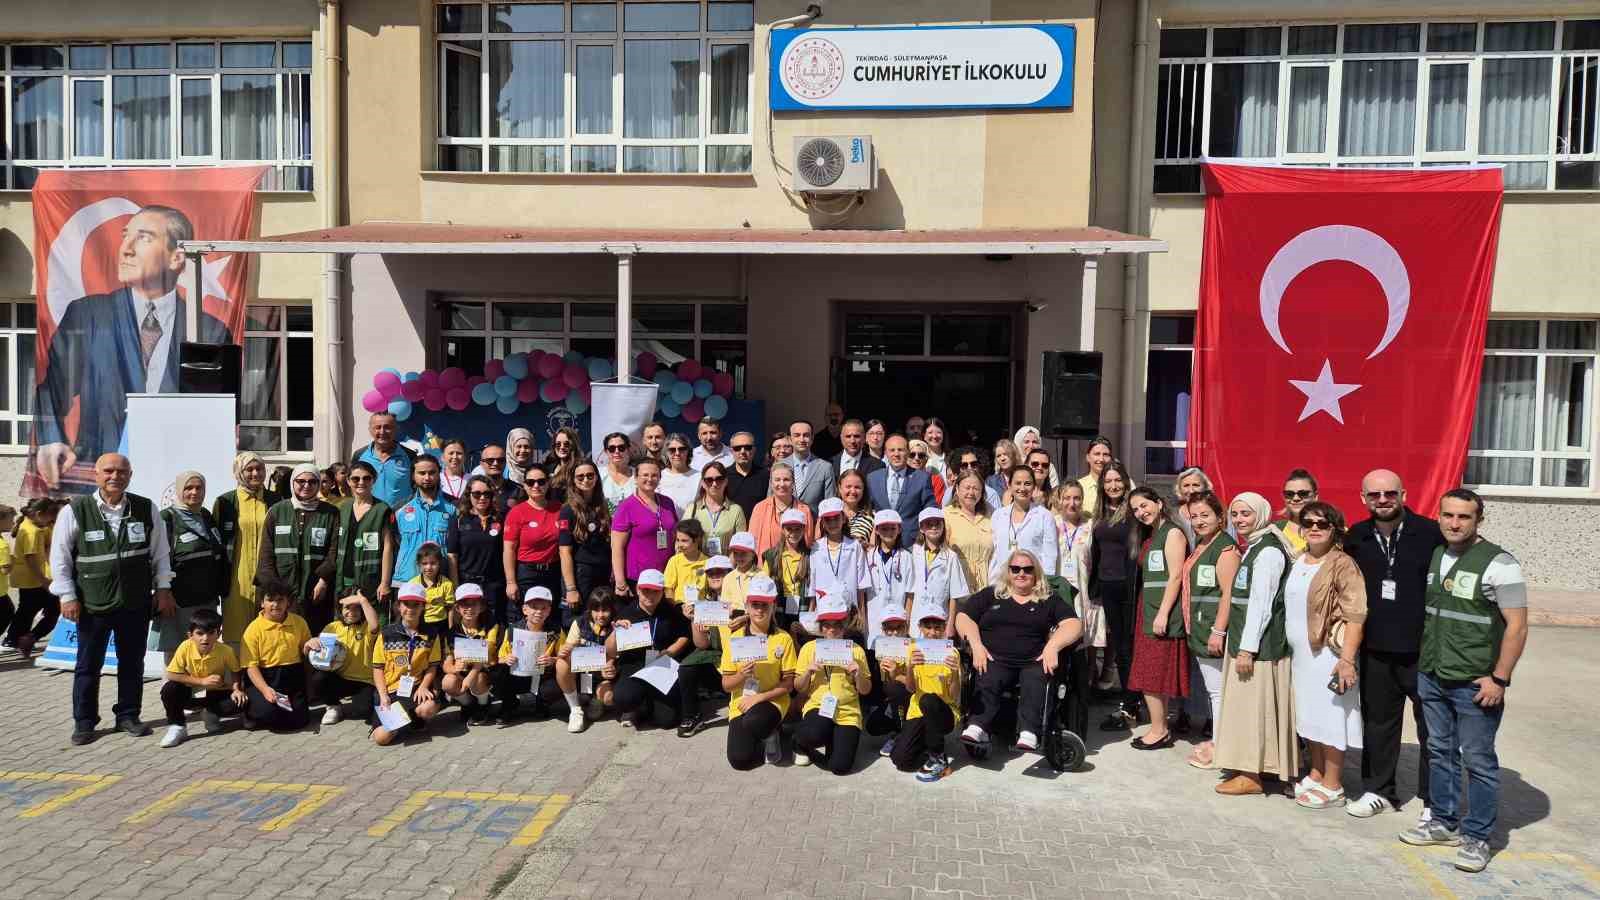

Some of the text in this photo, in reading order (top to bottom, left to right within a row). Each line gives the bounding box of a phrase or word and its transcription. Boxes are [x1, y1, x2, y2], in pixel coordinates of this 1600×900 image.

[853, 61, 961, 82] CUMHURİYET
[965, 60, 1047, 81] İLKOKULU
[851, 137, 861, 163] beko
